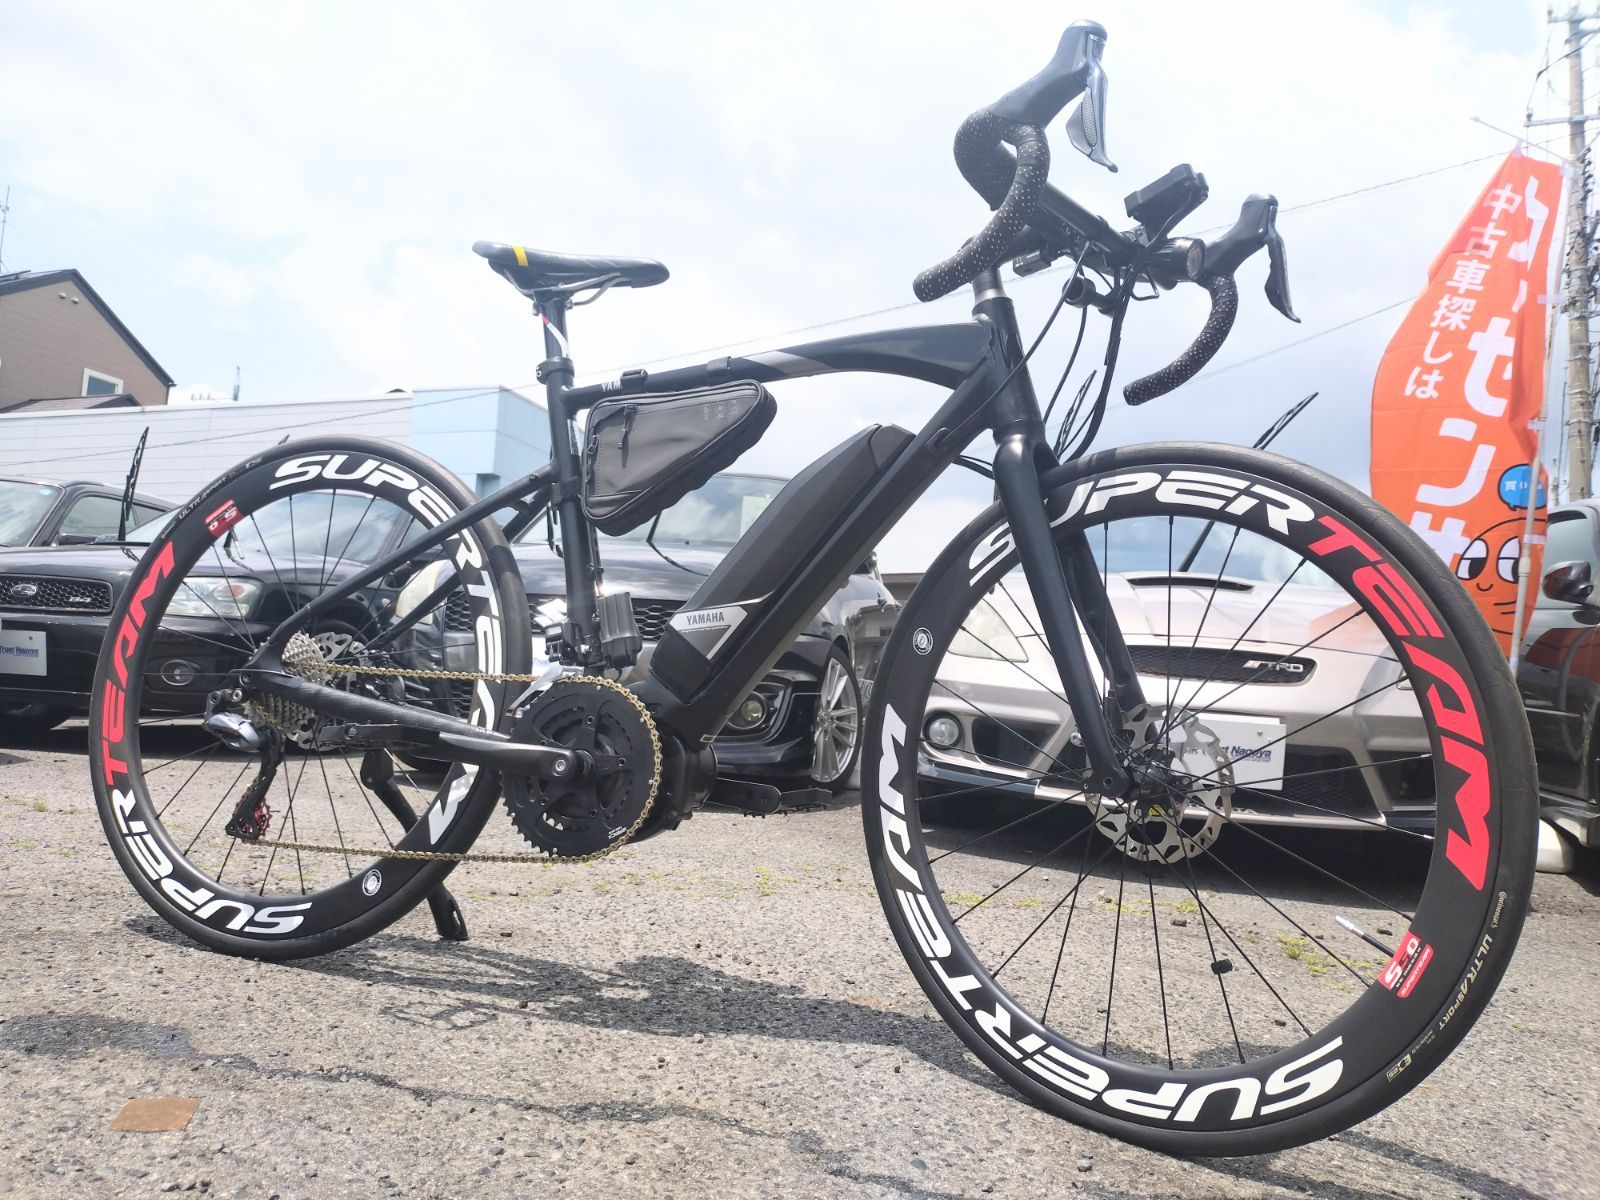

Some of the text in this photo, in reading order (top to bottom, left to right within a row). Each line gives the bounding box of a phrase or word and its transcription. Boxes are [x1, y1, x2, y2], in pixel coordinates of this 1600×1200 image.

[1404, 183, 1522, 399] 中古車探しは
[686, 611, 726, 626] YAMAHA
[1262, 660, 1305, 673] TRD
[1231, 745, 1272, 759] Nagoya
